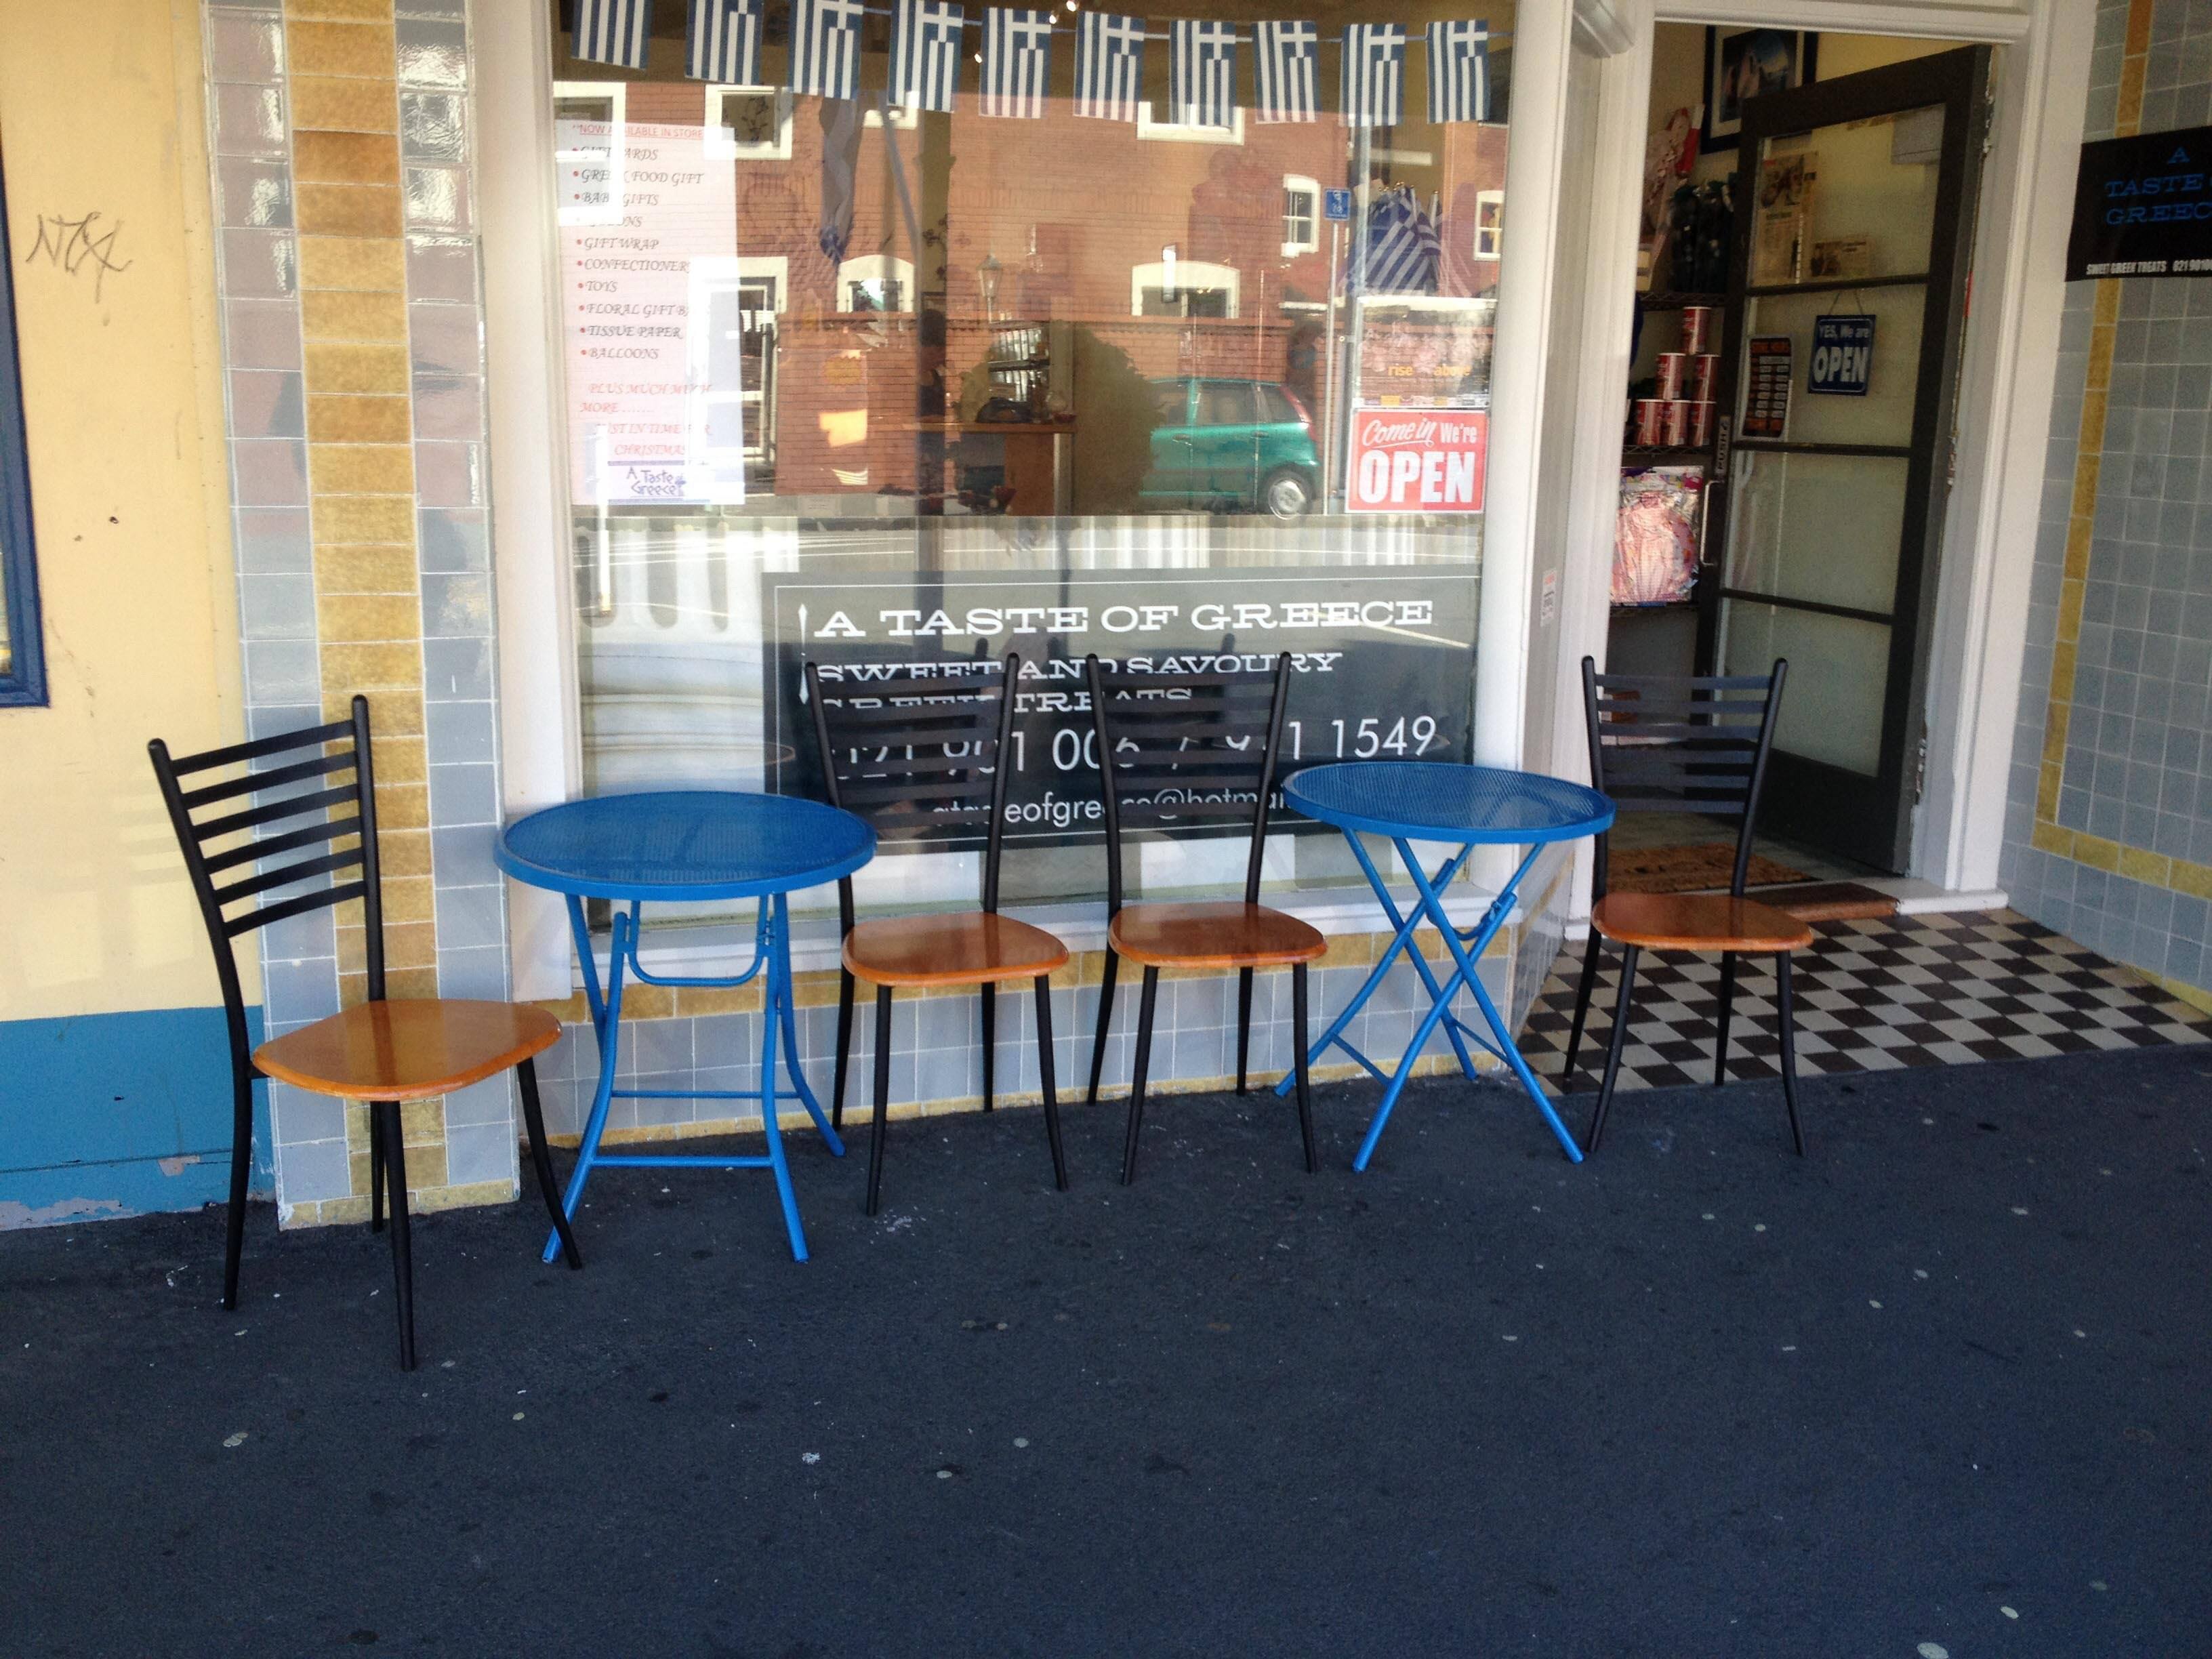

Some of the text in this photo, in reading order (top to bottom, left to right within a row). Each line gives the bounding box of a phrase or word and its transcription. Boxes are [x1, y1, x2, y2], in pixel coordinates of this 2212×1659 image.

[625, 148, 659, 161] ARDS
[2167, 146, 2190, 164] A
[632, 171, 668, 184] FOOD
[671, 173, 705, 186] GIFT
[2104, 173, 2204, 197] TASTE
[581, 192, 659, 207] BAB GIFTS
[584, 237, 659, 251] GIFT WRAP
[584, 258, 690, 273] CONFECTIONER
[586, 281, 618, 292] TOYS
[586, 304, 640, 316] FLORAL
[644, 304, 675, 318] GIFT
[589, 325, 684, 340] TISSUE PAPER
[589, 347, 660, 360] BALLOONS
[1389, 363, 1473, 377] rise above
[1813, 346, 1869, 383] OPEN
[1361, 417, 1477, 447] Come in We're
[614, 444, 686, 457] CHRISTMA
[640, 470, 674, 484] Taste
[1358, 449, 1476, 504] OPEN
[630, 480, 676, 495] Greece
[814, 600, 1434, 638] A TASTE OF GREECE
[817, 661, 1002, 682] SWEET
[1126, 652, 1343, 674] SAVOURY
[1331, 715, 1436, 759] 1549
